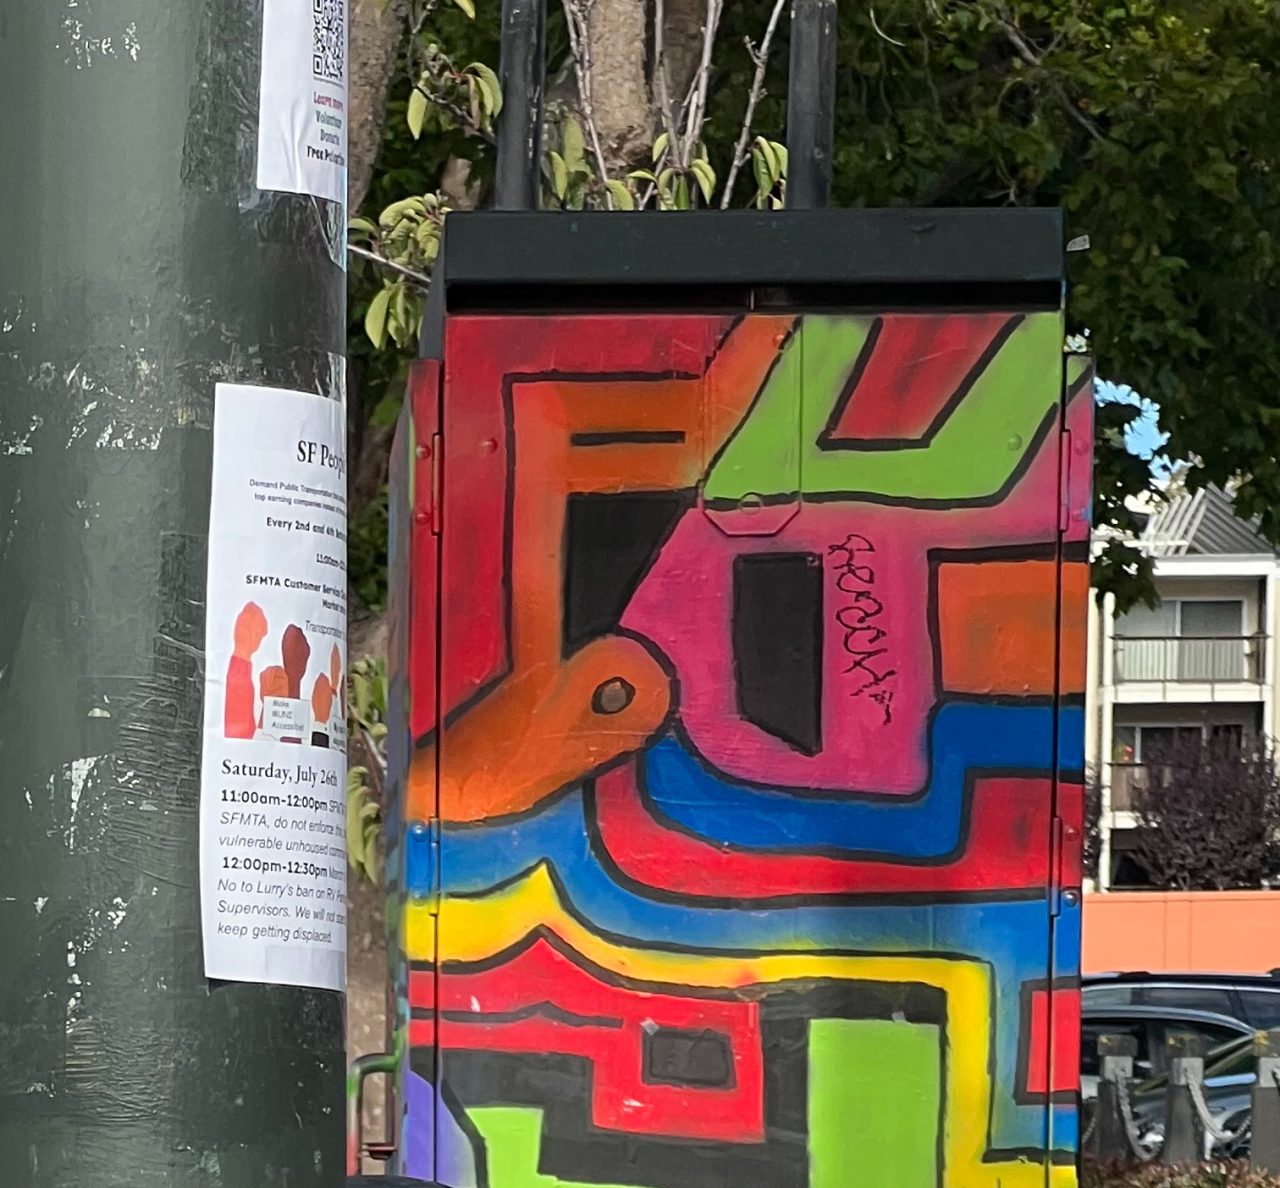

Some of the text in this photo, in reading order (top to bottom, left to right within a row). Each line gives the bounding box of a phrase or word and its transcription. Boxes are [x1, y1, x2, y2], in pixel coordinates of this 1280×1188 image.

[297, 440, 317, 464] SF
[249, 479, 278, 490] Demand
[280, 481, 300, 493] Public
[254, 493, 266, 503] top
[266, 517, 293, 531] Every
[295, 520, 310, 532] 2nd
[246, 575, 281, 588] SFMTA
[284, 579, 321, 593] Customer
[221, 758, 293, 785] Saturday,
[294, 765, 319, 789] July
[220, 811, 270, 829] SFMTA,
[273, 815, 288, 830] do
[291, 819, 307, 832] not
[219, 835, 283, 851] vulnerable
[286, 841, 329, 856] unhoused
[218, 879, 236, 892] No
[241, 880, 253, 894] to
[296, 885, 315, 898] ban
[218, 900, 291, 918] Supervisors.
[295, 905, 311, 920] We
[218, 922, 248, 937] keep
[252, 926, 291, 942] getting
